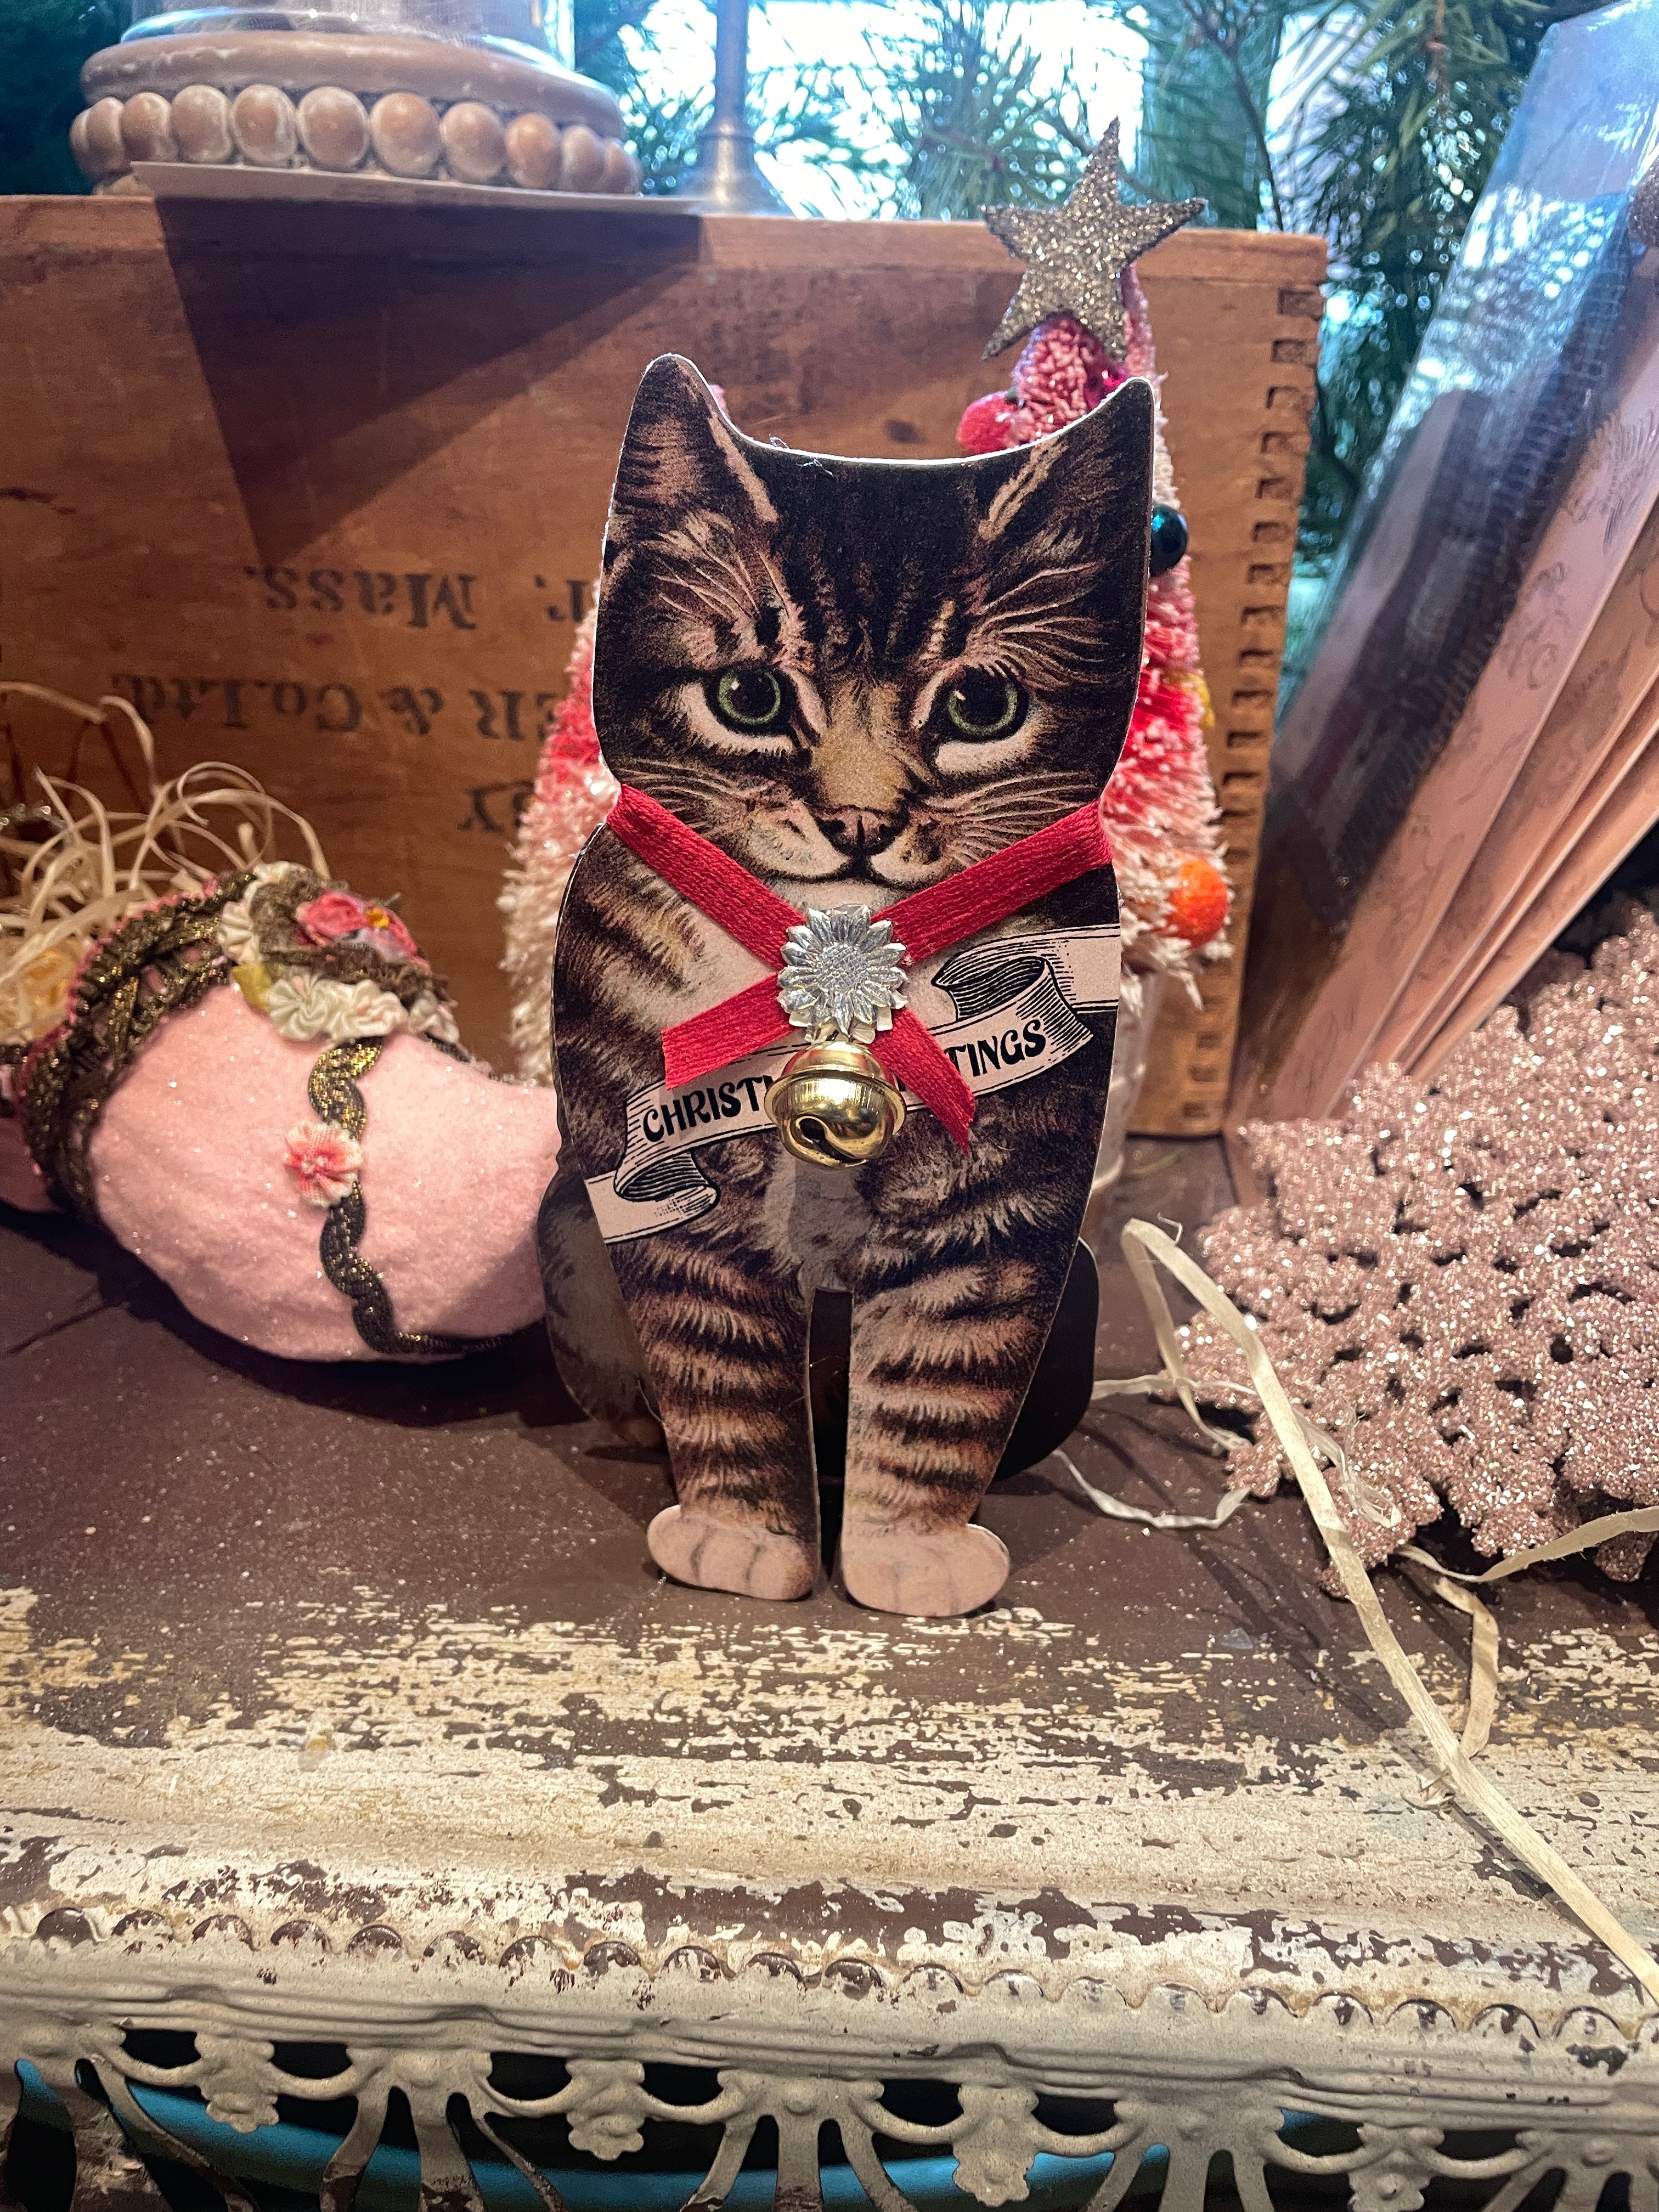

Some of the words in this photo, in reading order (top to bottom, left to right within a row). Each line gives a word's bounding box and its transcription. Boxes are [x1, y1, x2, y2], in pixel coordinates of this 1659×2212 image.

[244, 568, 476, 630] Mass.
[385, 688, 443, 736] &
[643, 1075, 774, 1142] CHRIST
[945, 1019, 1046, 1077] TINGS
